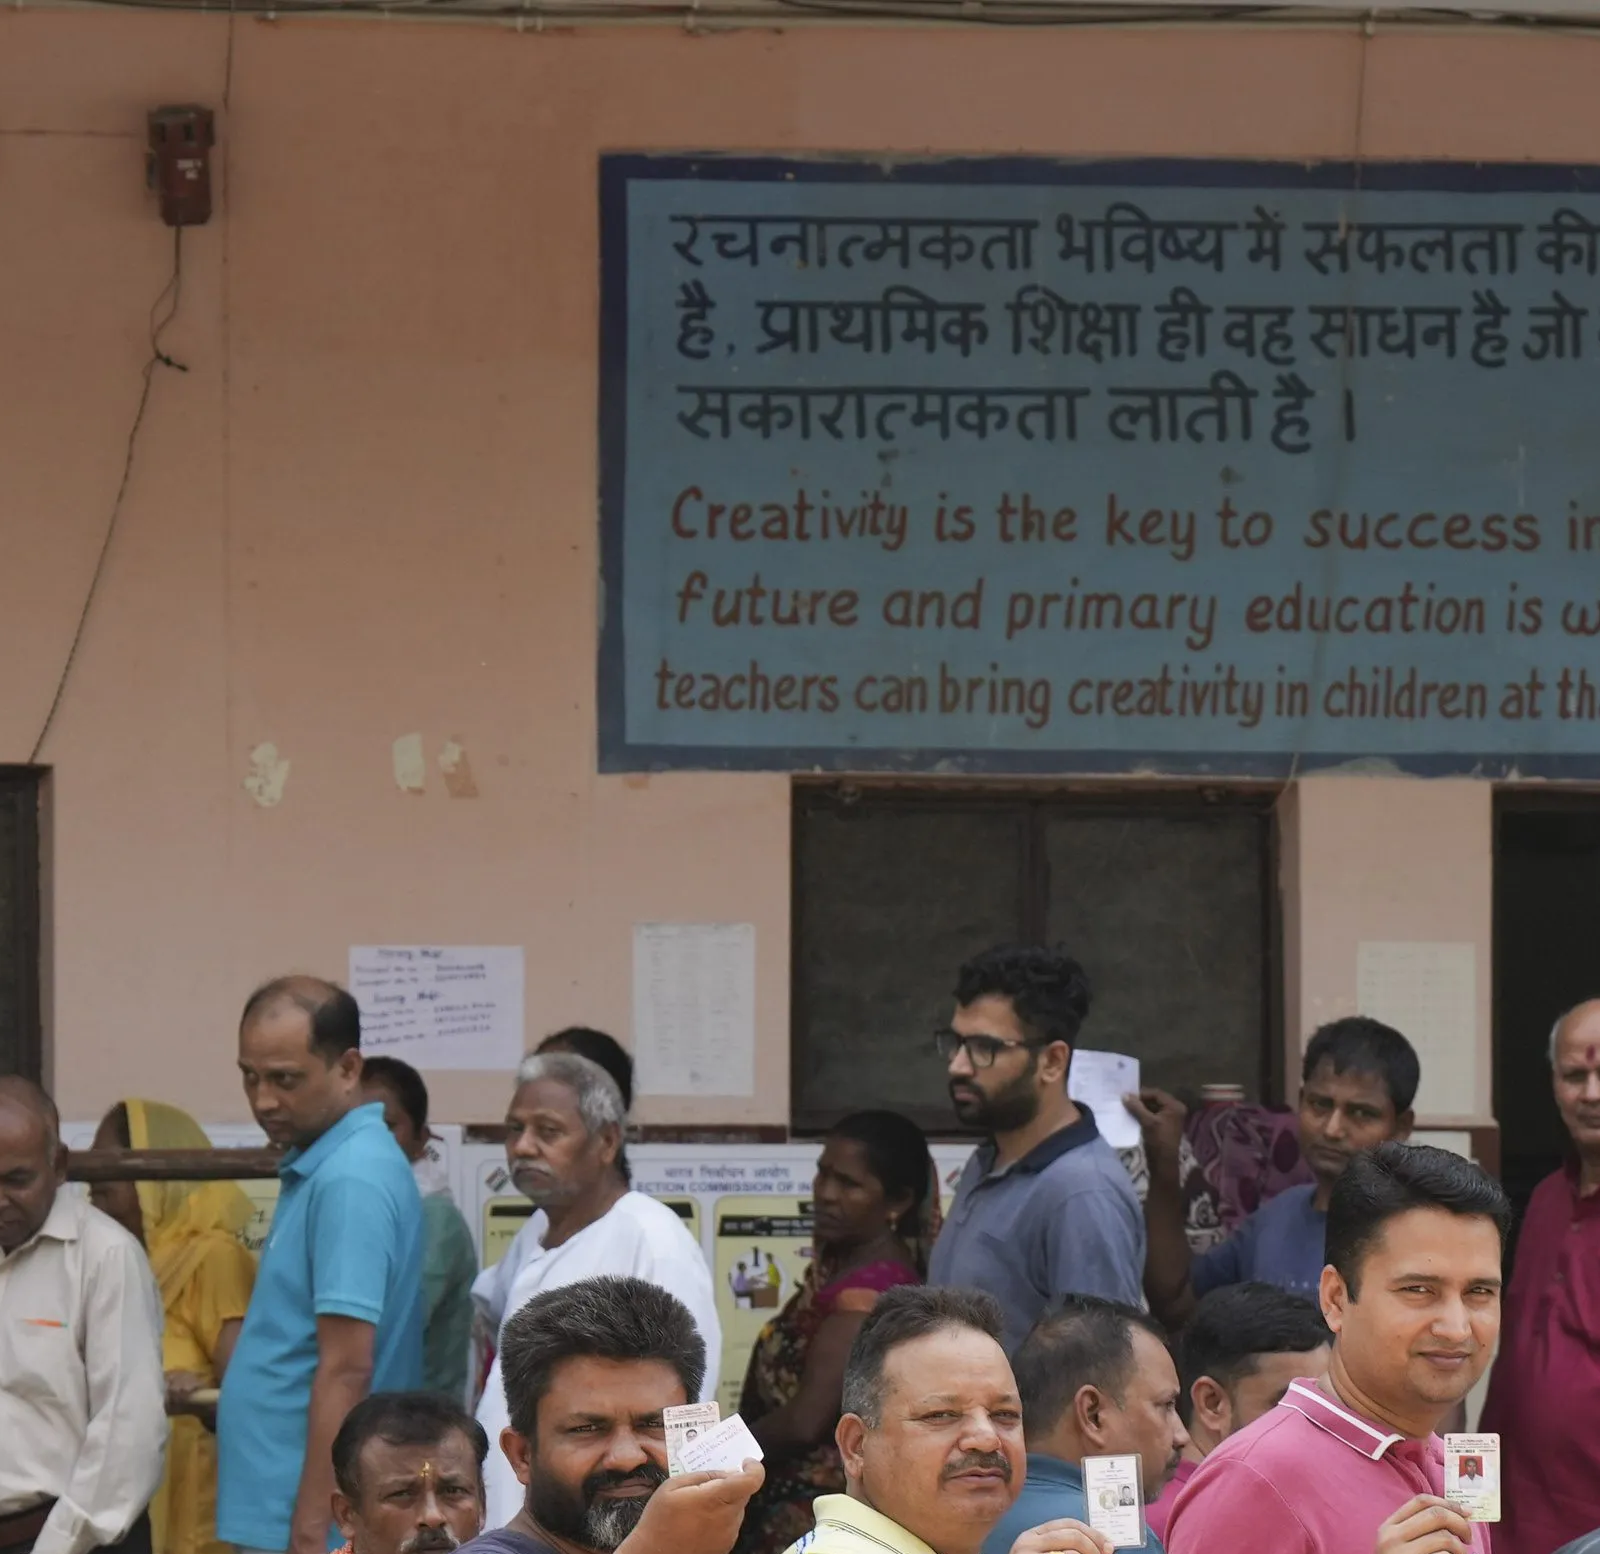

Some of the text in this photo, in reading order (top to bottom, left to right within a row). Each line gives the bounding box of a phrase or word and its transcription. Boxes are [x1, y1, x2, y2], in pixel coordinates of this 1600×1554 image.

[670, 214, 1039, 269] रचनात्मकता
[1055, 203, 1238, 274] भविष्य
[1245, 205, 1286, 272] में
[1303, 222, 1523, 276] सफलता
[755, 285, 989, 358] प्राथमिक
[1005, 284, 1141, 364] शिक्षा
[1154, 286, 1213, 362] ही
[1222, 305, 1295, 368] वह
[1308, 305, 1461, 359] साधन
[1470, 288, 1511, 369] है
[1522, 289, 1589, 361] जो
[676, 384, 1091, 441] सकारात्मकता
[1107, 368, 1259, 443] लाती
[1270, 373, 1316, 455] है
[671, 485, 909, 552] Creativity
[934, 491, 977, 543] is
[996, 491, 1079, 545] the
[1103, 493, 1198, 562] key
[1218, 498, 1274, 550] to
[1303, 508, 1543, 553] success
[676, 569, 861, 629] future
[881, 577, 985, 630] and
[1005, 577, 1218, 651] primary
[1245, 581, 1487, 636] education
[1506, 581, 1545, 637] is
[653, 658, 841, 715] teachers
[852, 673, 928, 714] can
[938, 660, 1053, 730] bring
[1068, 662, 1265, 729] creativity
[1274, 662, 1309, 719] in
[1323, 664, 1489, 721] children
[1498, 666, 1547, 722] at
[689, 1181, 774, 1193] COMMISSION
[777, 1181, 795, 1193] OF
